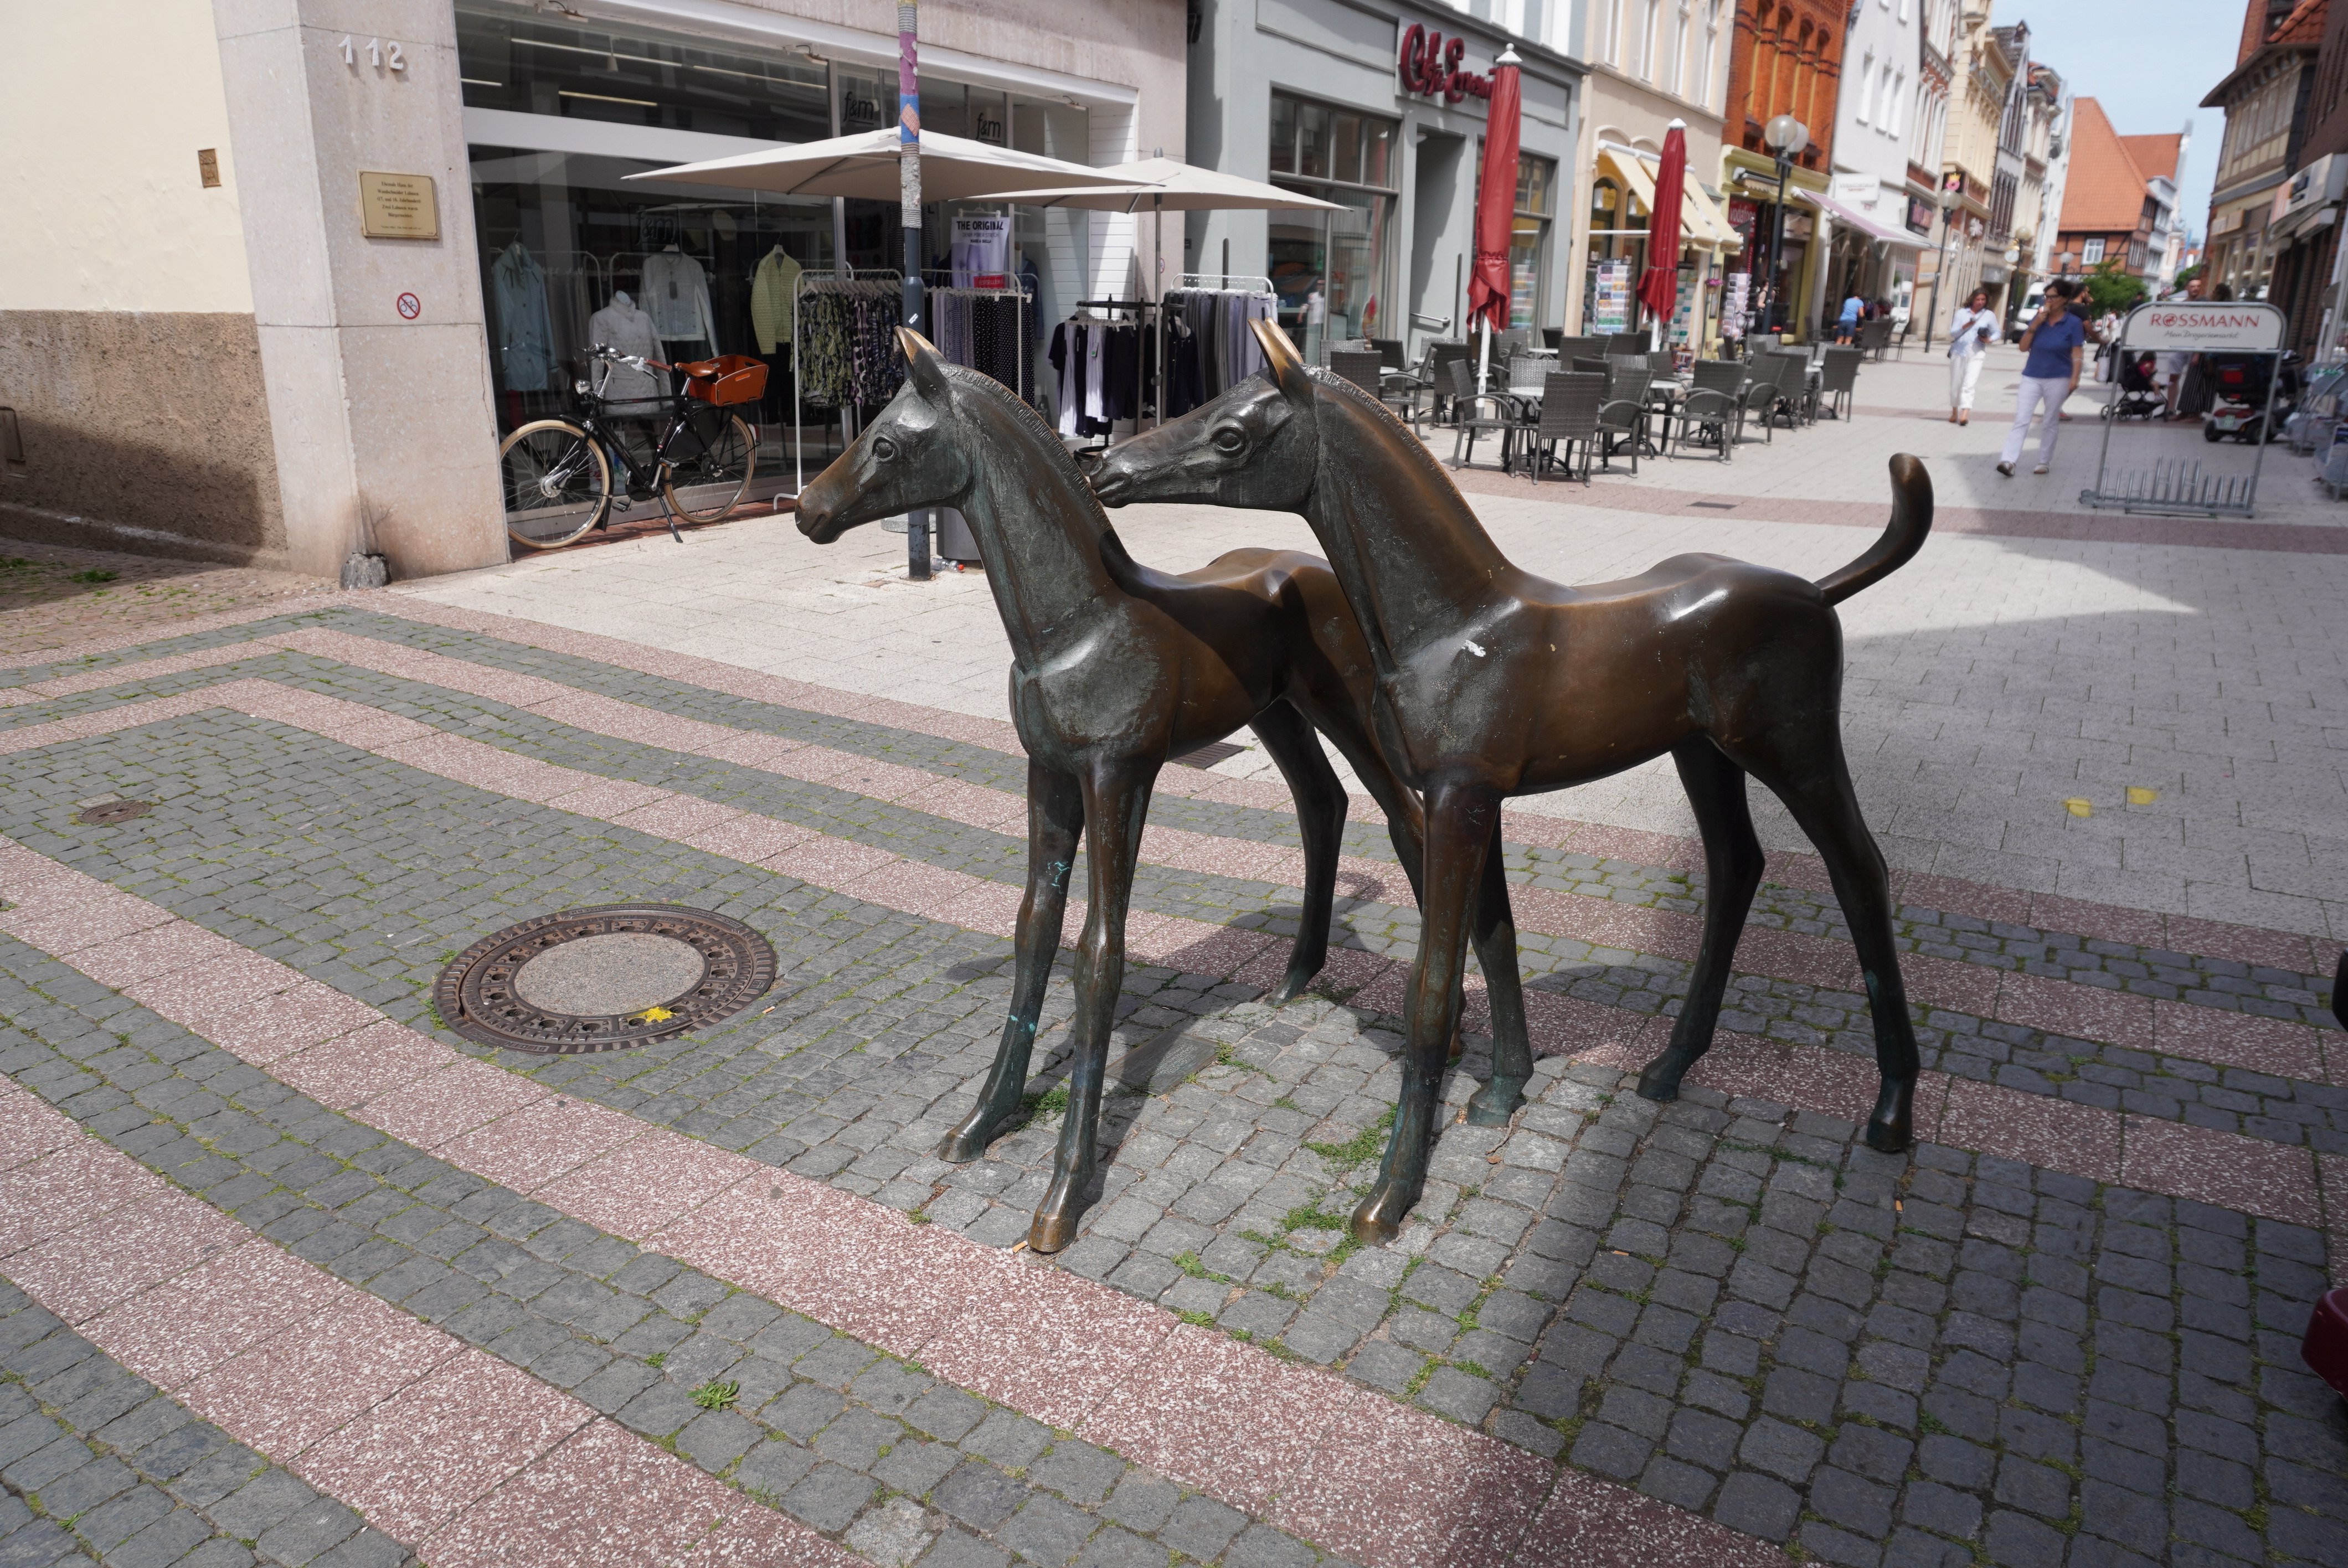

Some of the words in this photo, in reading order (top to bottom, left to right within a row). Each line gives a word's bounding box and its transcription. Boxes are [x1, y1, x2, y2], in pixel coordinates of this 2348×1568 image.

[338, 34, 404, 70] 112
[843, 91, 874, 122] f&m
[976, 112, 1001, 140] f&m
[956, 220, 971, 230] THE
[2150, 313, 2260, 328] ROSSMANN
